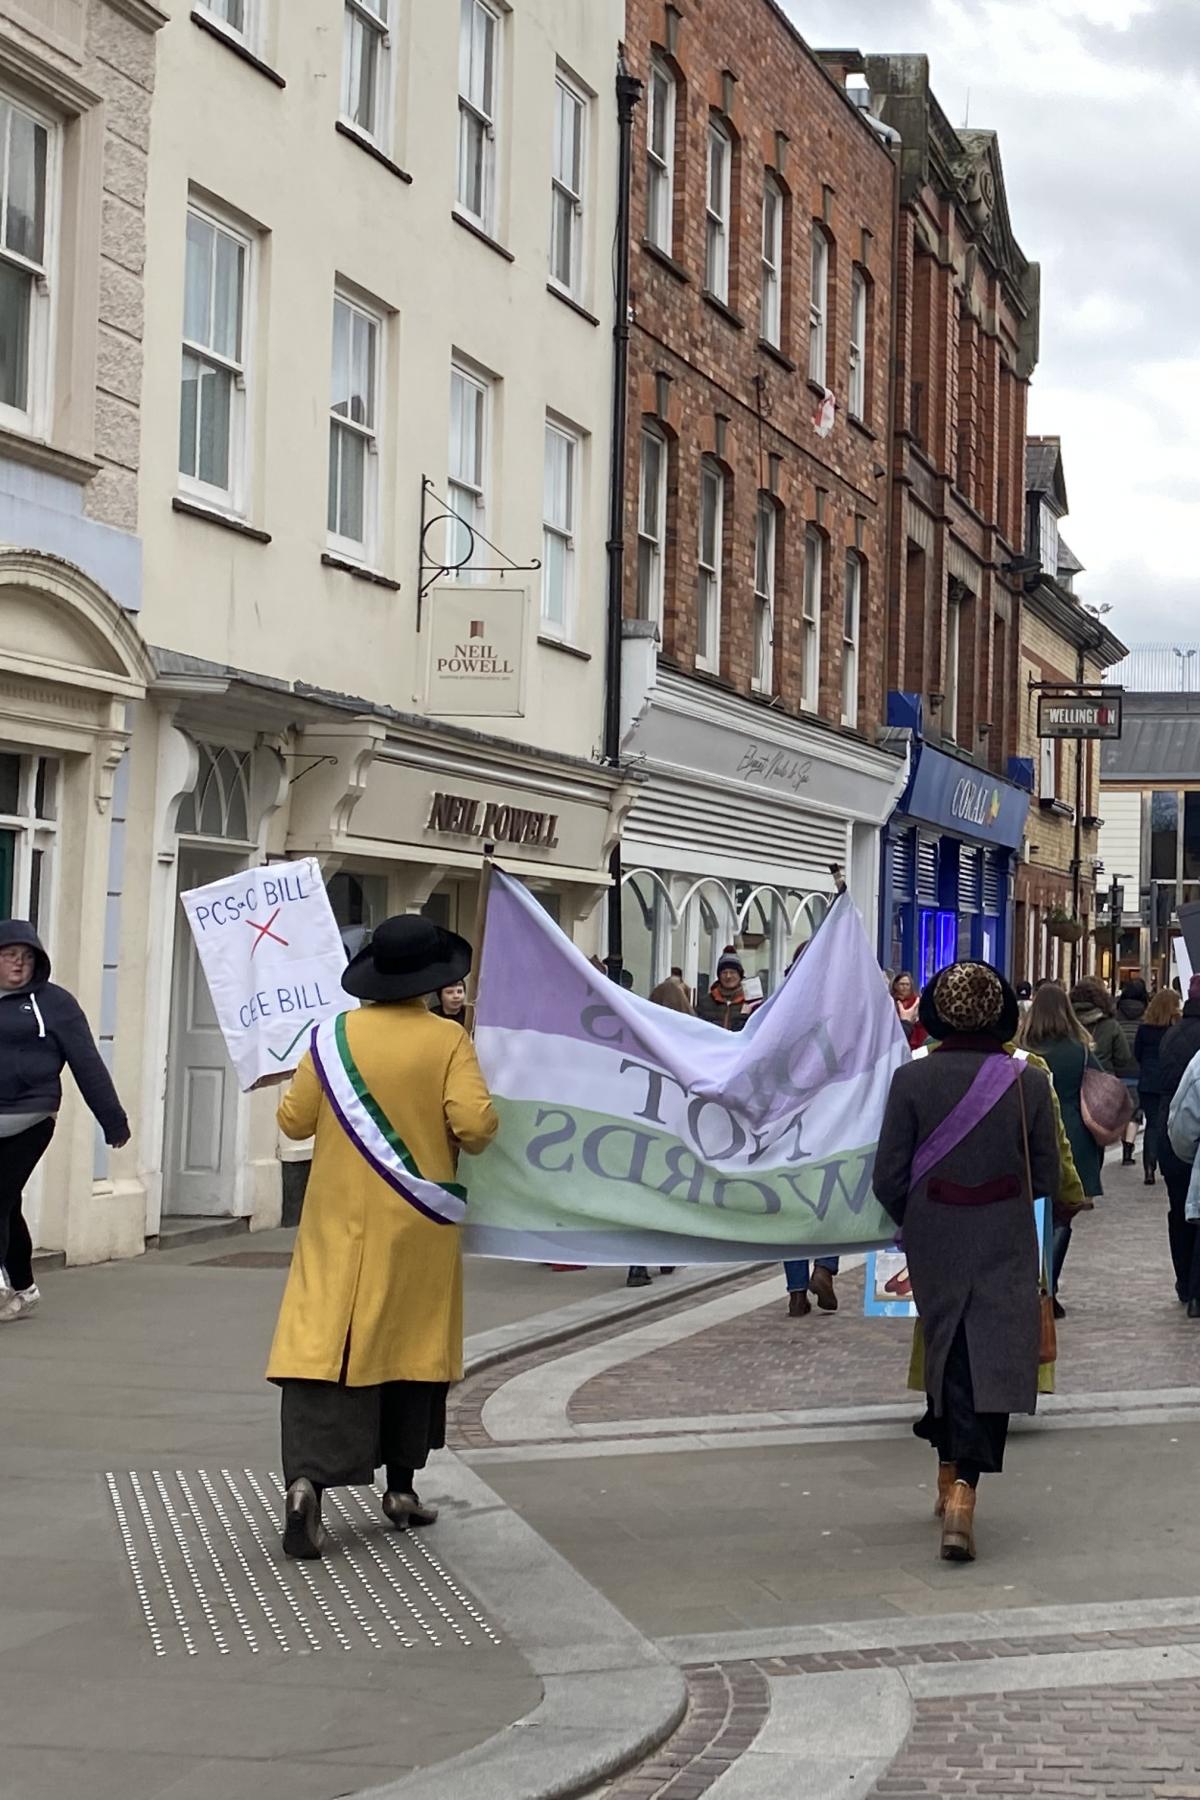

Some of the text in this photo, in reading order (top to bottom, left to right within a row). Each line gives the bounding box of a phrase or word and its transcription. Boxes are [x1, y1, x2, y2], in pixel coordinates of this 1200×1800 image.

[437, 658, 514, 674] POWELL
[453, 644, 499, 659] NEIL
[426, 791, 559, 849] NEIL POWELL
[951, 778, 988, 825] CORAL
[263, 876, 310, 907] BILL
[239, 981, 331, 1029] CEE BILL
